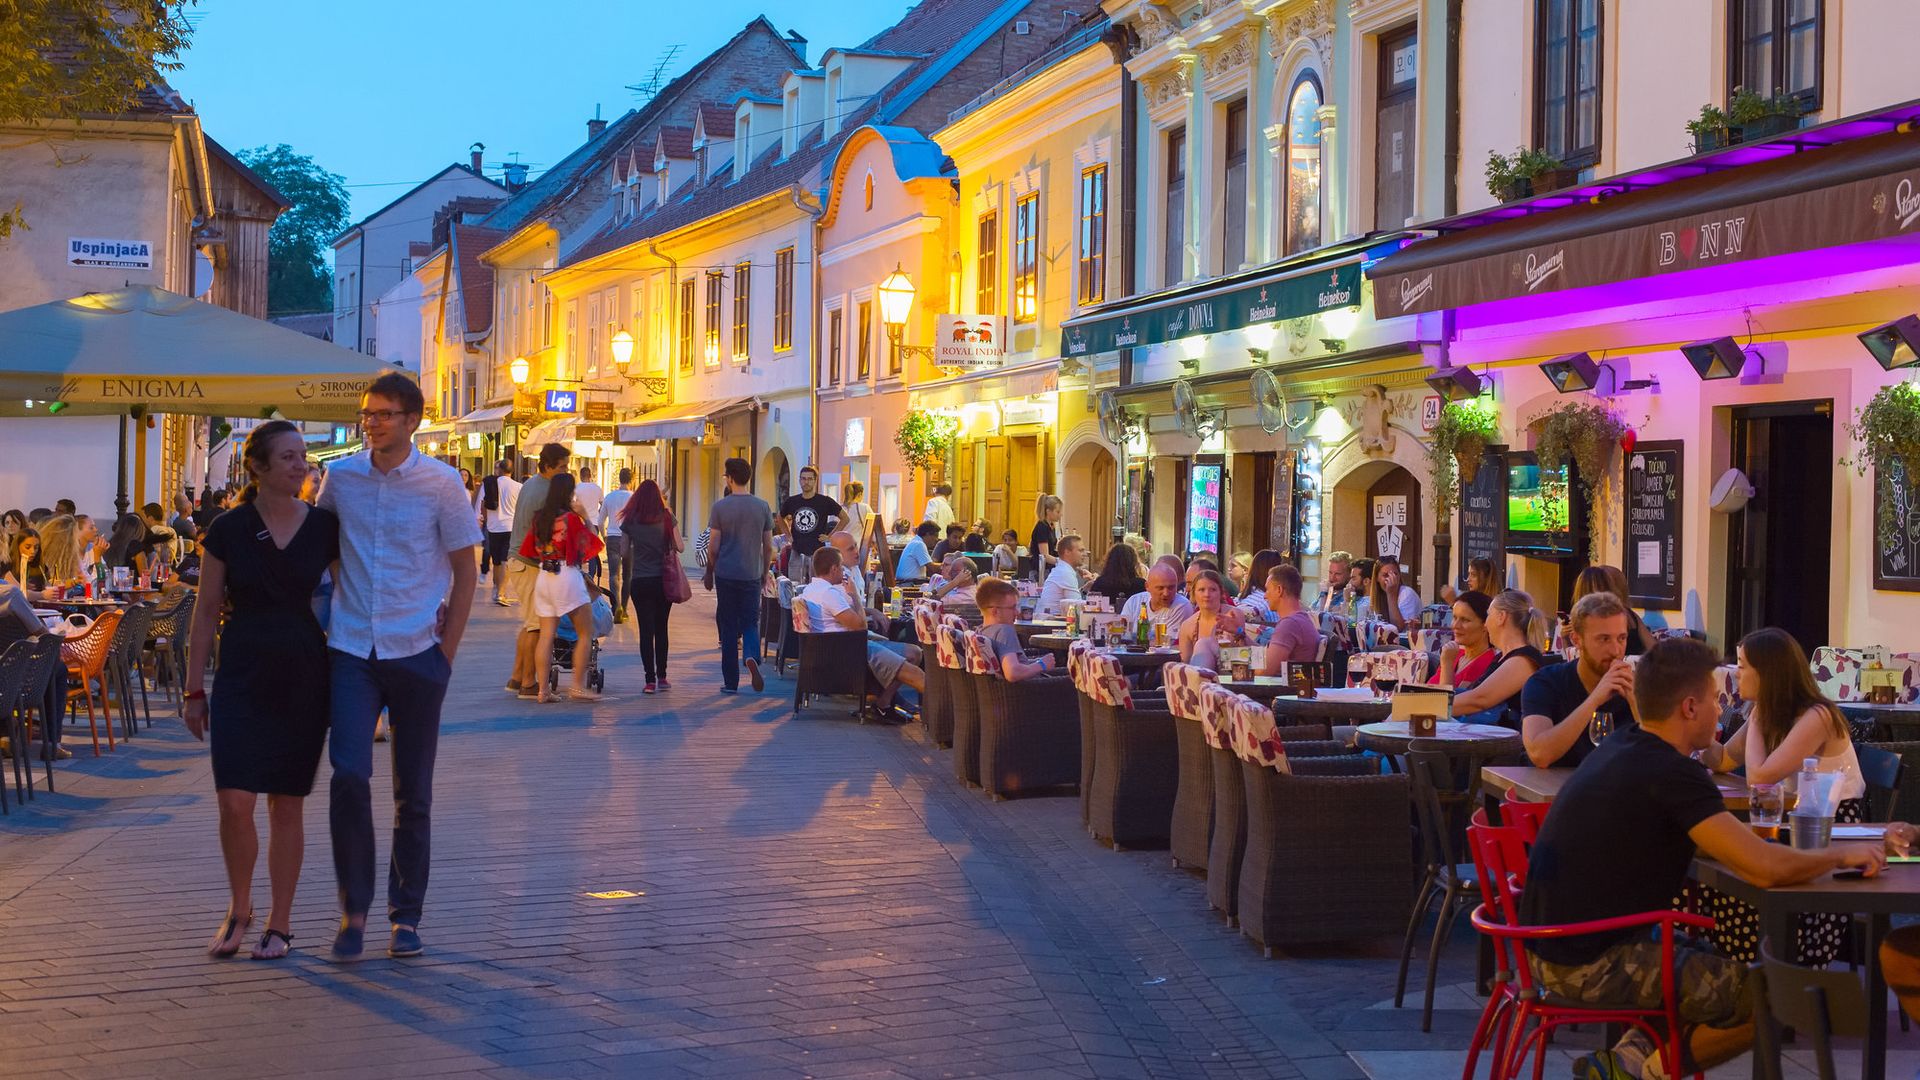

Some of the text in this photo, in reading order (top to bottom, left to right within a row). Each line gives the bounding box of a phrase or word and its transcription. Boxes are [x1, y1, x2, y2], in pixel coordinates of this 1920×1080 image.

[1318, 286, 1350, 308] Heineken
[1188, 302, 1214, 331] DONNA
[1249, 301, 1277, 322] Heineken
[1115, 331, 1137, 347] Heineken
[942, 346, 1004, 357] ROYAL INDIA
[101, 379, 205, 399] ENIGMA
[1426, 400, 1437, 419] 24
[1646, 475, 1663, 492] AMBER
